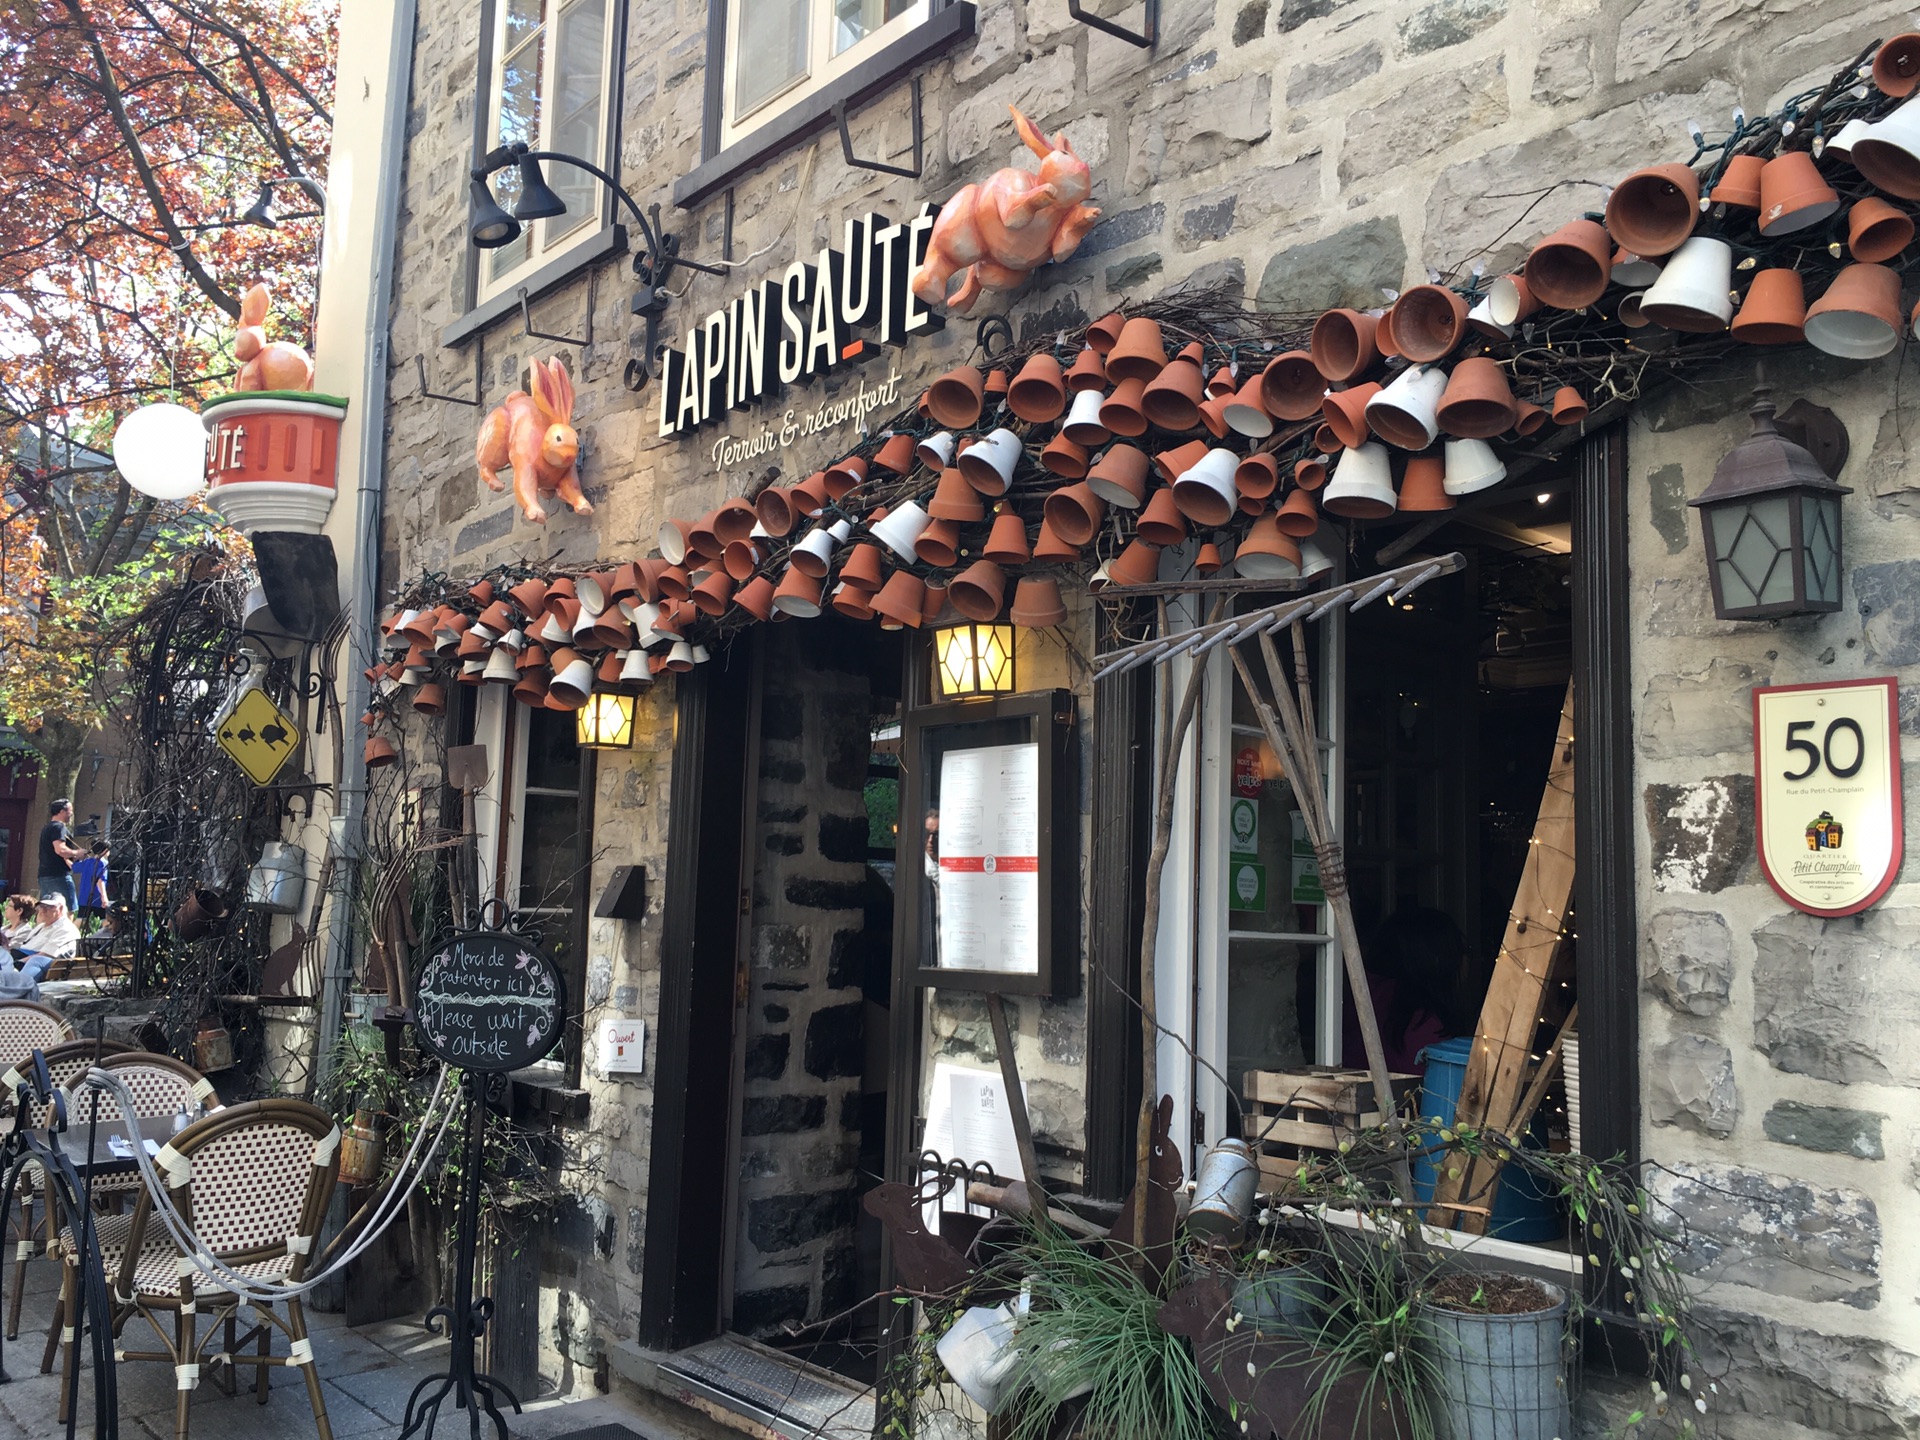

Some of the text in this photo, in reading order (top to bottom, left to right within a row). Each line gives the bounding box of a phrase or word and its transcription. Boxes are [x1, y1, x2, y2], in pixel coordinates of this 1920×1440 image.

[659, 202, 935, 439] LAPIN SAUTÉ
[712, 367, 903, 471] Terroir & réconfort
[206, 423, 244, 471] UTÉ
[1783, 717, 1865, 781] 50
[1810, 786, 1864, 794] Petit-Champlain
[1791, 859, 1861, 877] Petit Champlain
[451, 943, 505, 970] Merci de
[440, 970, 523, 992] patienter ici
[427, 1001, 527, 1030] Please wait
[608, 1029, 636, 1043] Ouvert
